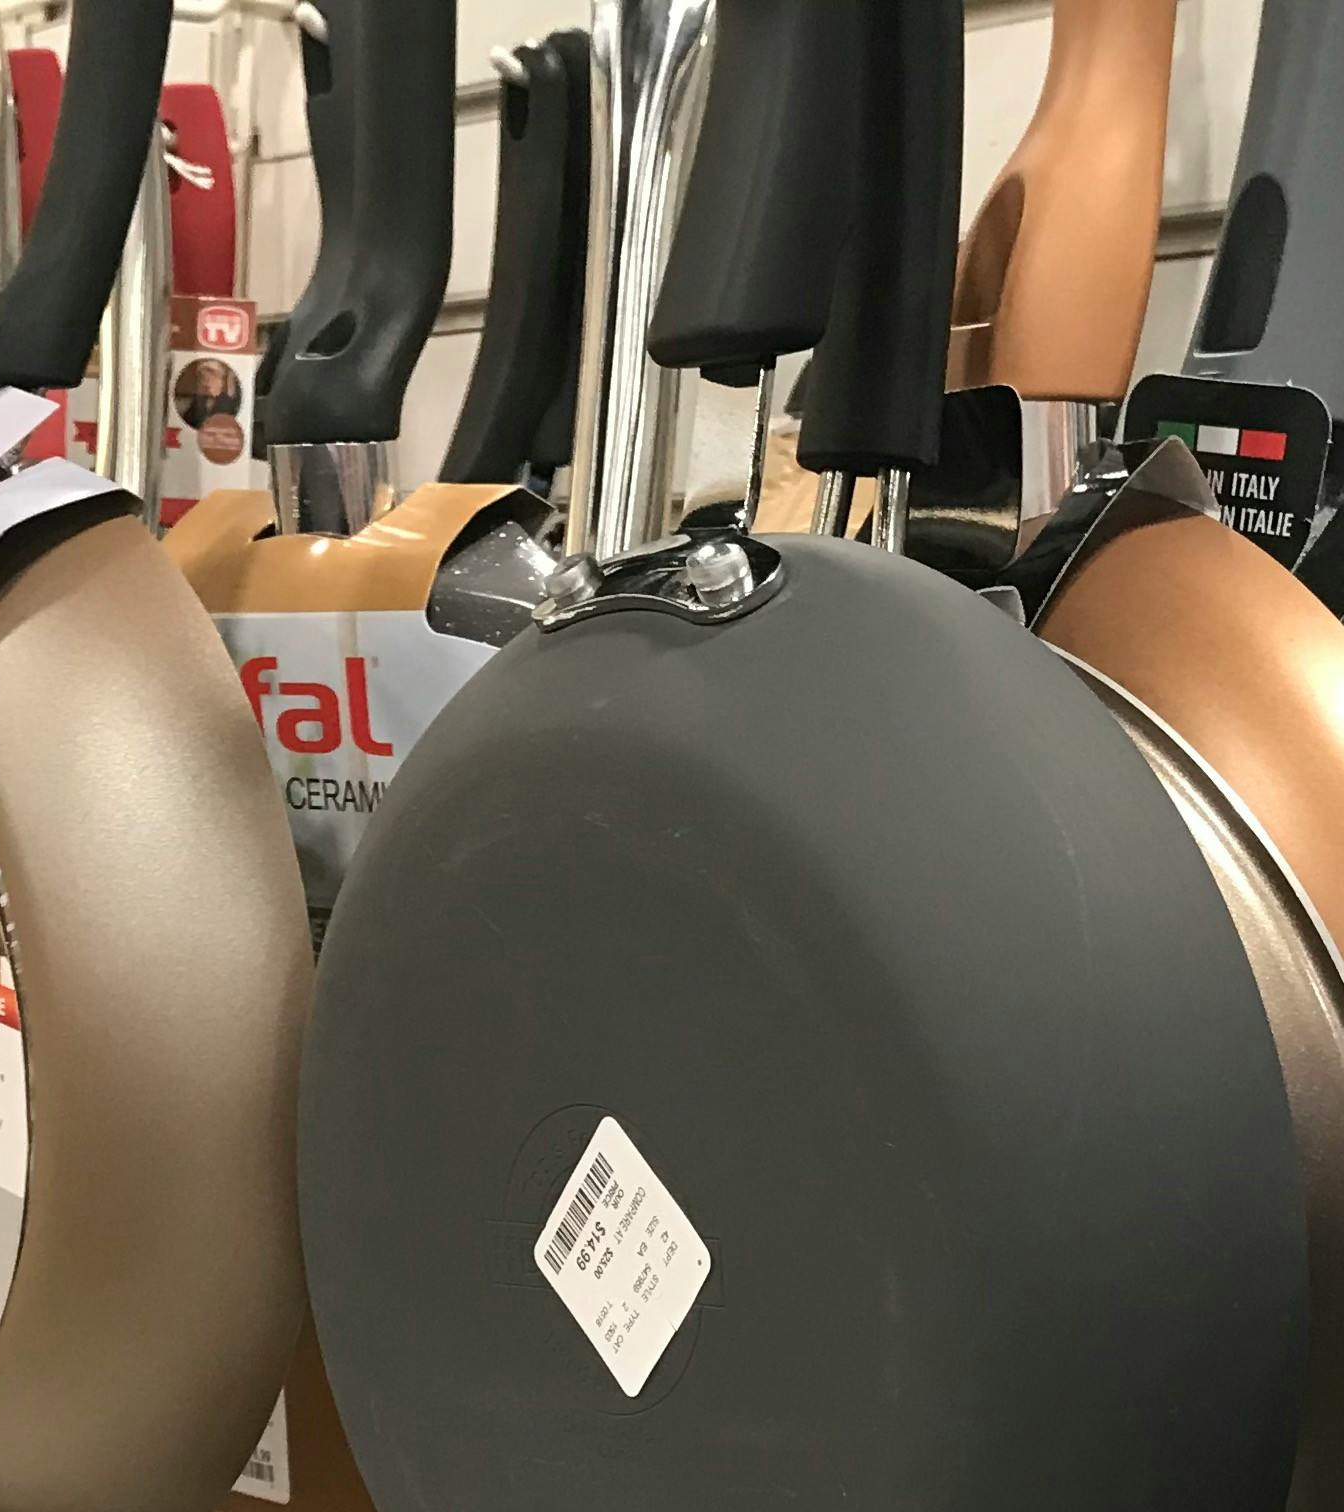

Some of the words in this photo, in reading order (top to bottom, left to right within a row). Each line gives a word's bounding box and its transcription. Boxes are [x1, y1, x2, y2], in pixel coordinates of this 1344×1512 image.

[1231, 471, 1281, 501] ITALY
[1221, 504, 1236, 530] N
[1239, 507, 1295, 538] ITALIE
[240, 656, 394, 758] fal
[619, 1186, 646, 1232] COMPARE
[576, 1221, 607, 1272] $14.99
[594, 1246, 614, 1280] $25.00
